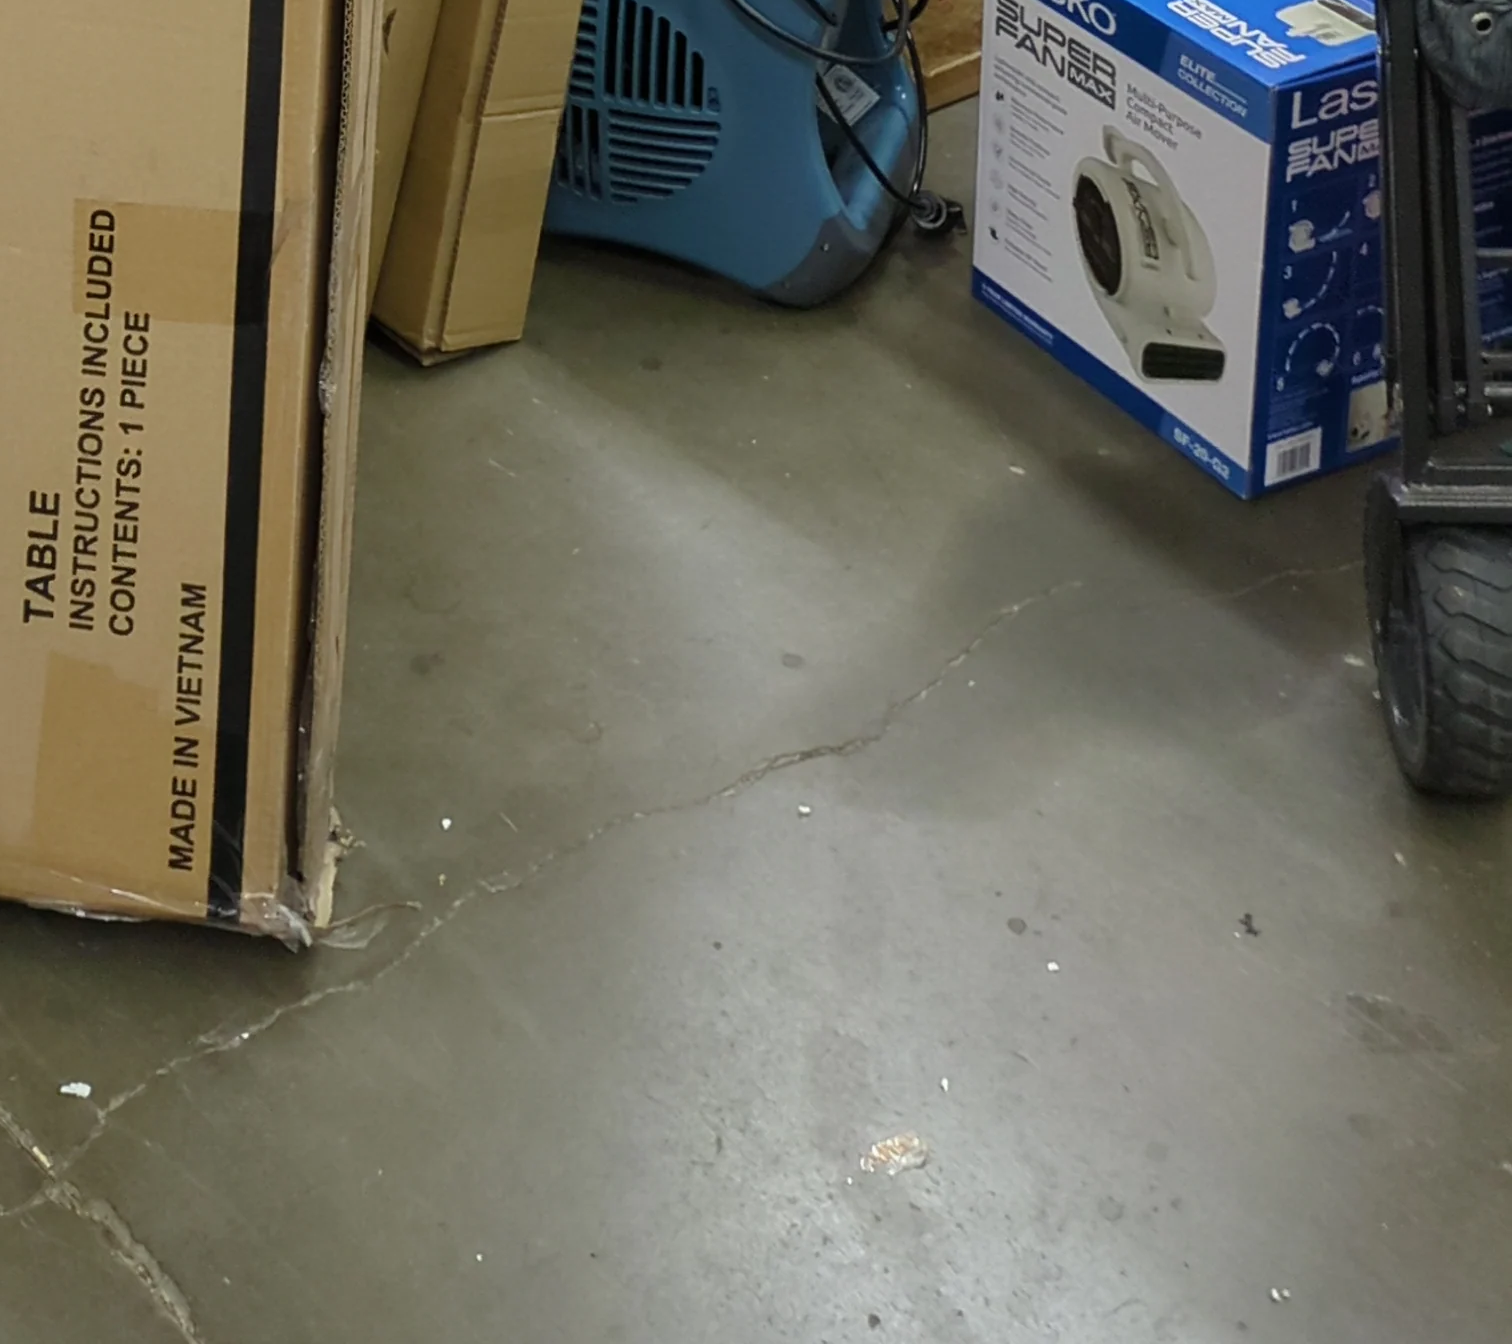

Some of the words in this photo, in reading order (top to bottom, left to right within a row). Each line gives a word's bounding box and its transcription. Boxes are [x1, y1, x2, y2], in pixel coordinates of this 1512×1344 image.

[995, 14, 1066, 78] FAN
[1070, 64, 1115, 109] MAX
[1166, 0, 1289, 69] SUPER
[1226, 20, 1307, 63] FAN
[1177, 67, 1248, 118] COLLECTION
[1178, 54, 1217, 83] ELITE
[1125, 96, 1175, 135] Compact
[1126, 83, 1204, 140] Multi-Purpose
[1290, 78, 1379, 131] Las
[1143, 118, 1180, 151] Mover
[1287, 118, 1380, 162] SUPE
[1285, 142, 1361, 183] FAN
[81, 207, 116, 377] INCLUDED
[118, 311, 151, 409] PIECE
[122, 416, 145, 436] 1
[69, 384, 108, 633] INSTRUCTIONS
[23, 489, 62, 625] TABLE
[108, 444, 144, 637] CONTENTS:
[174, 582, 208, 725] VIETNAM
[174, 737, 202, 776] IN
[168, 779, 198, 871] MADE
